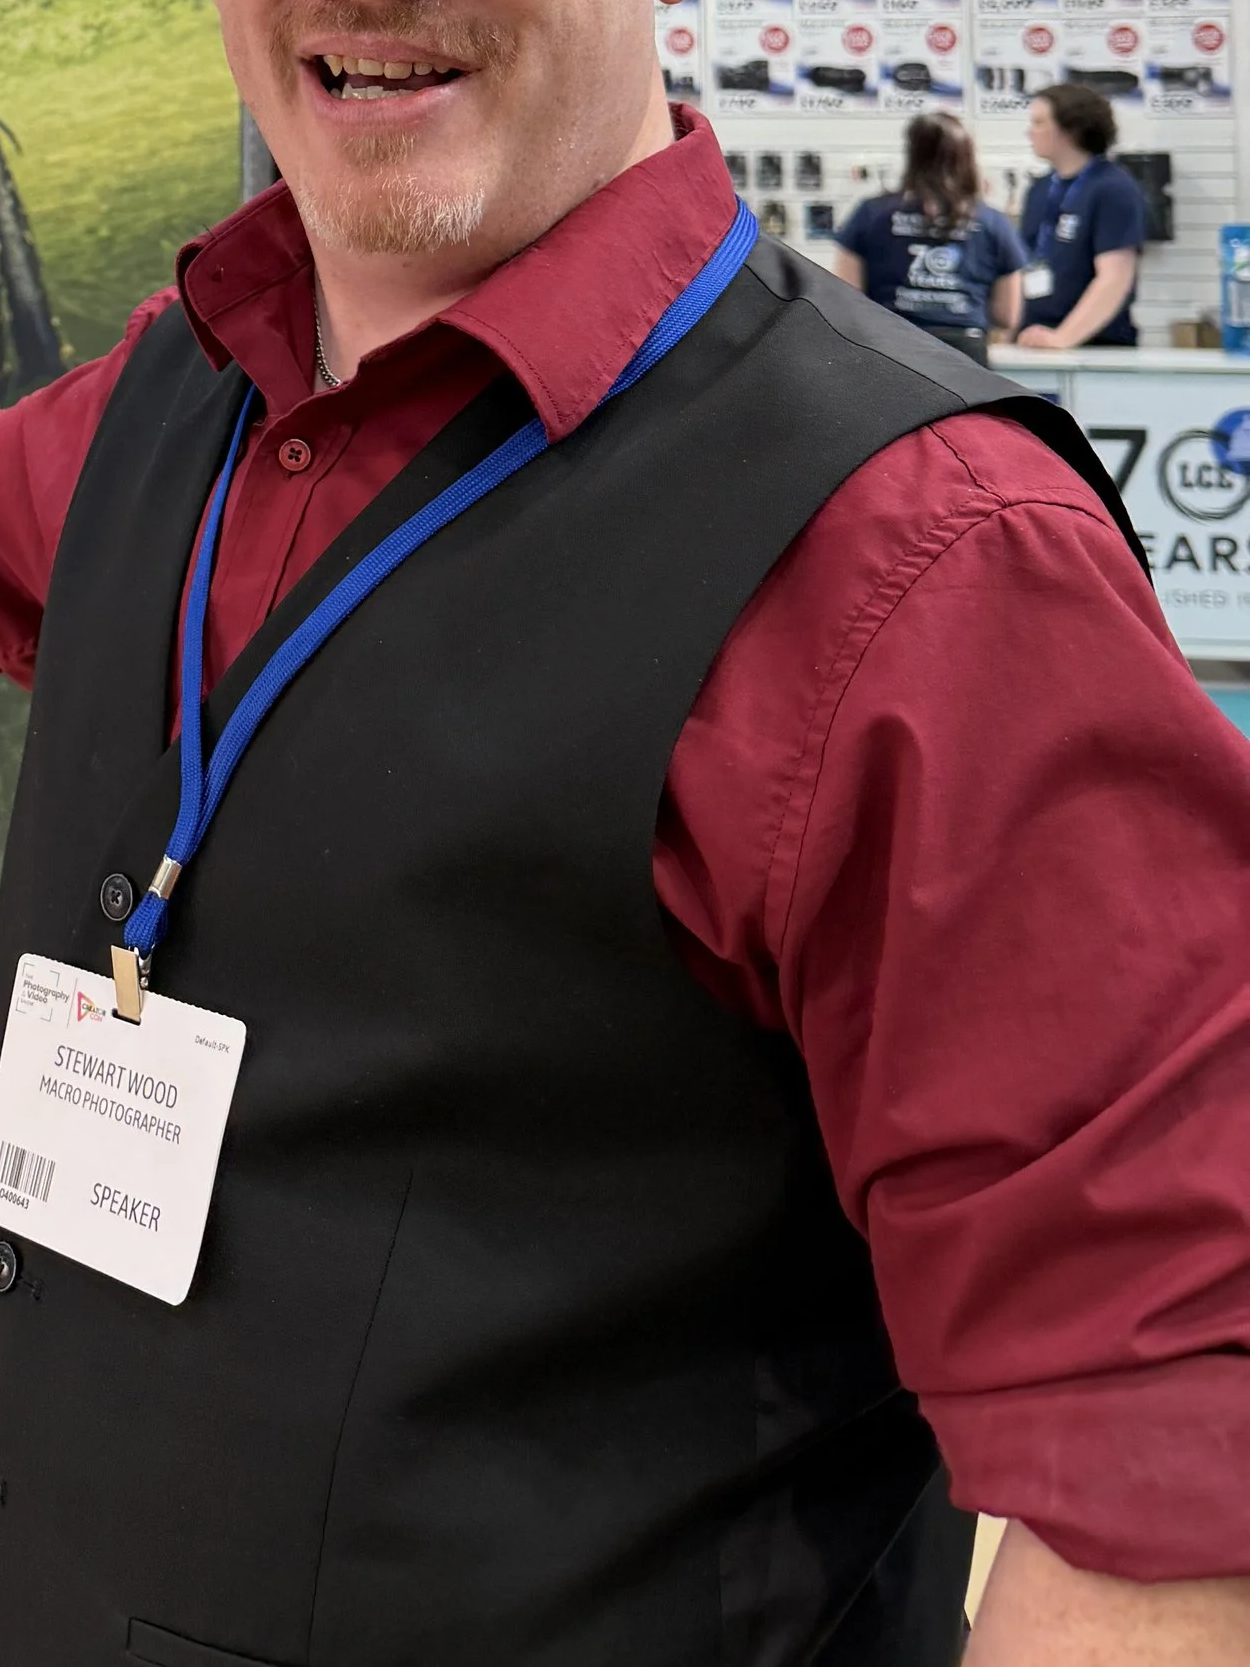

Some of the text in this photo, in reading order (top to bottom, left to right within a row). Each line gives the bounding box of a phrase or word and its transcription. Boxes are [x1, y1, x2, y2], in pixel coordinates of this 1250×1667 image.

[1177, 461, 1234, 489] LCE
[22, 979, 71, 1004] Photography
[26, 990, 48, 1004] Video
[54, 1045, 179, 1109] STEWART WOOD
[39, 1074, 182, 1145] MACRO PHOTOGRAPHER
[90, 1182, 162, 1232] SPEAKER
